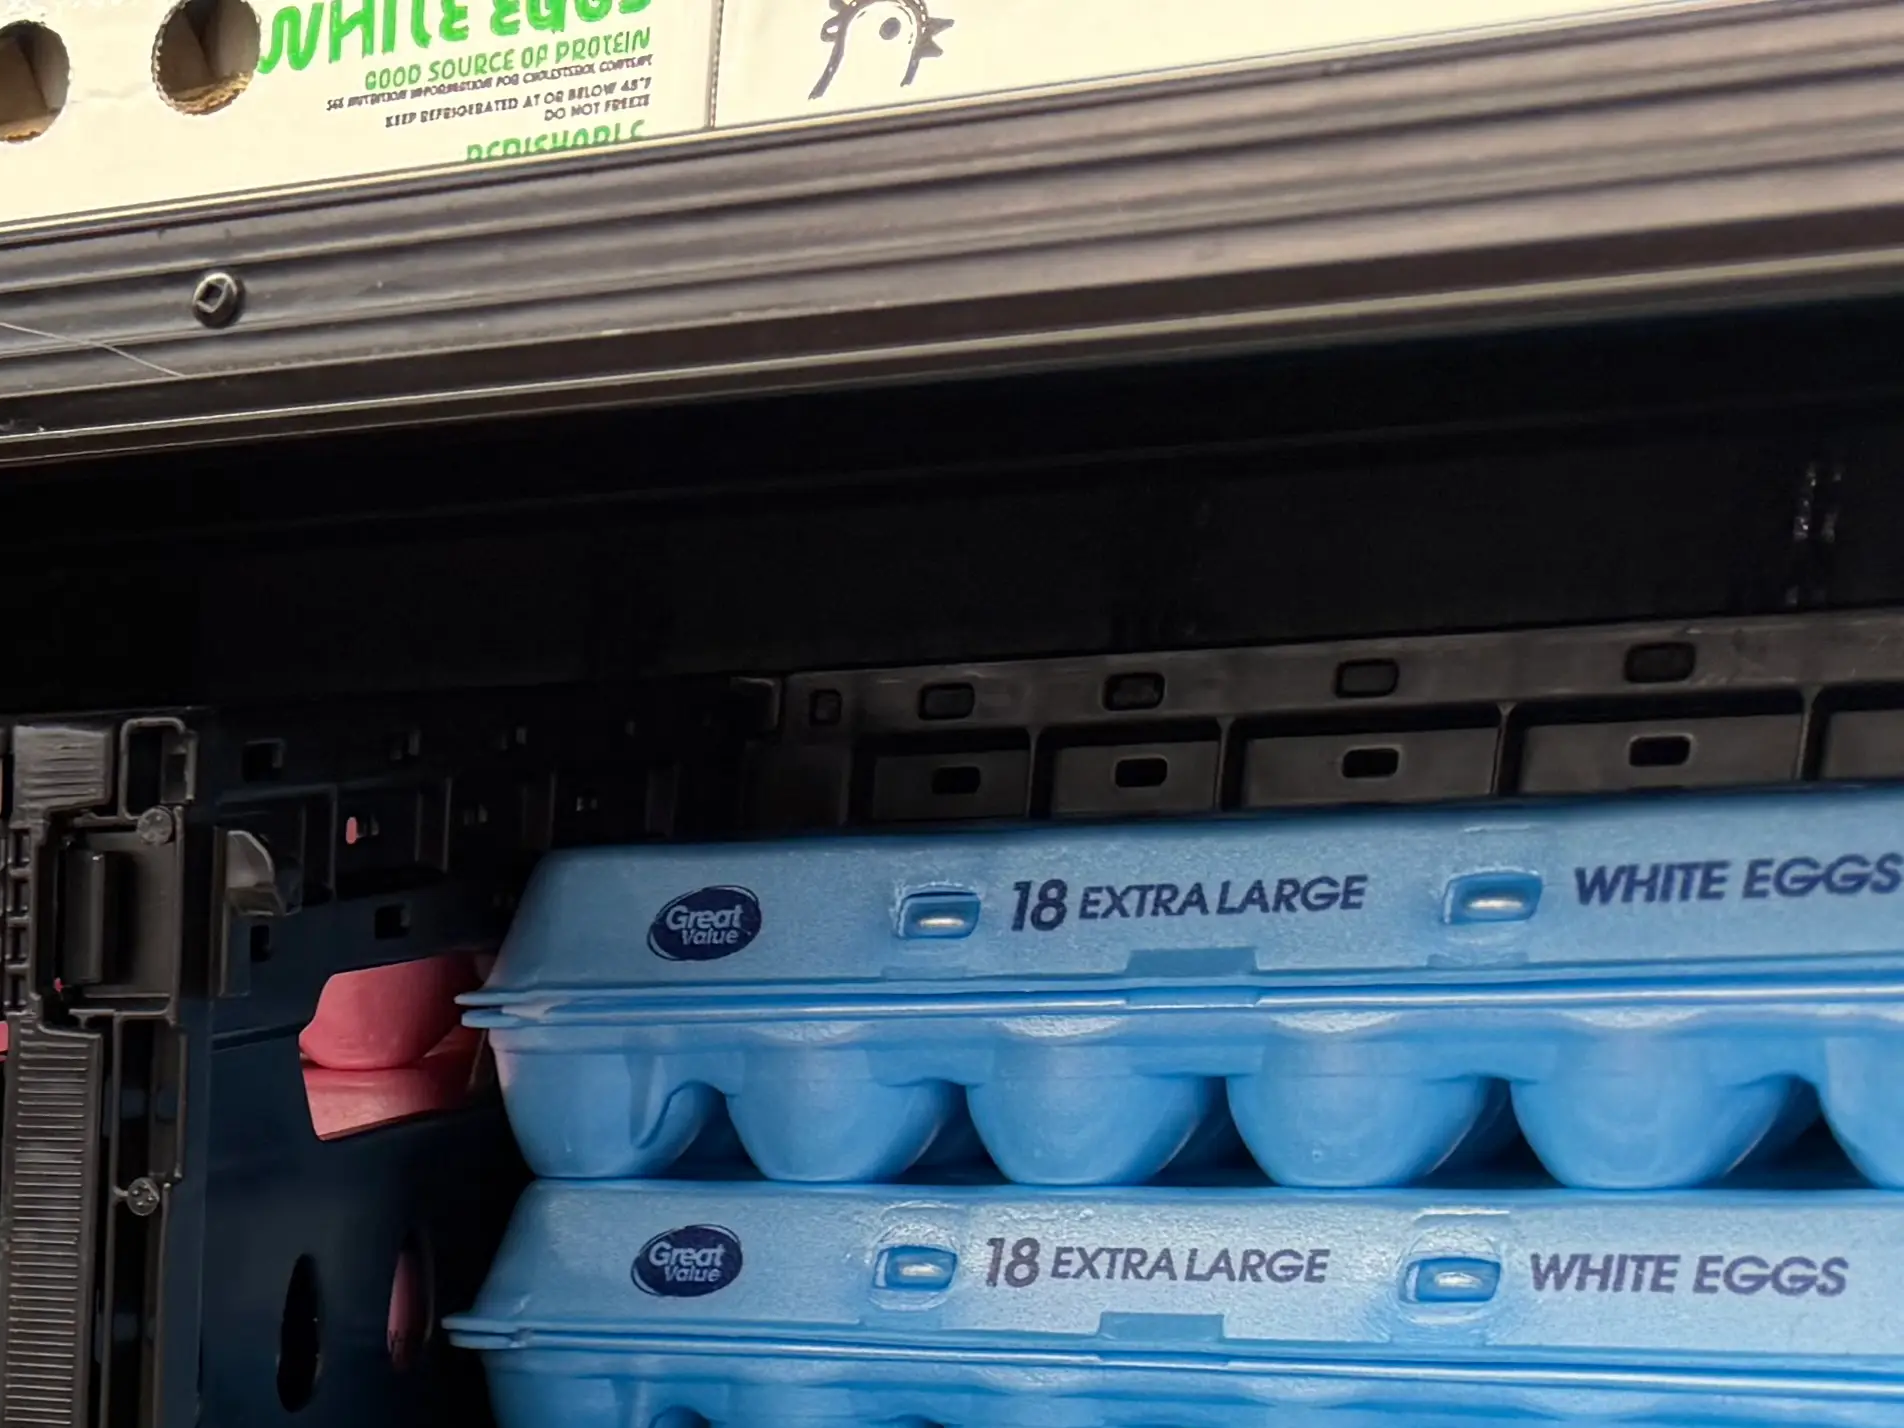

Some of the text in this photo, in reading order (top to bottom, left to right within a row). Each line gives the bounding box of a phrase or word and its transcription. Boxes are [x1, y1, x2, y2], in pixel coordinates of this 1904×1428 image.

[365, 27, 650, 90] GOOD SOURCE OF PROTEIN
[666, 903, 744, 932] Great
[1011, 853, 1904, 932] 18 EXTRA LARGE WHITE EGGS
